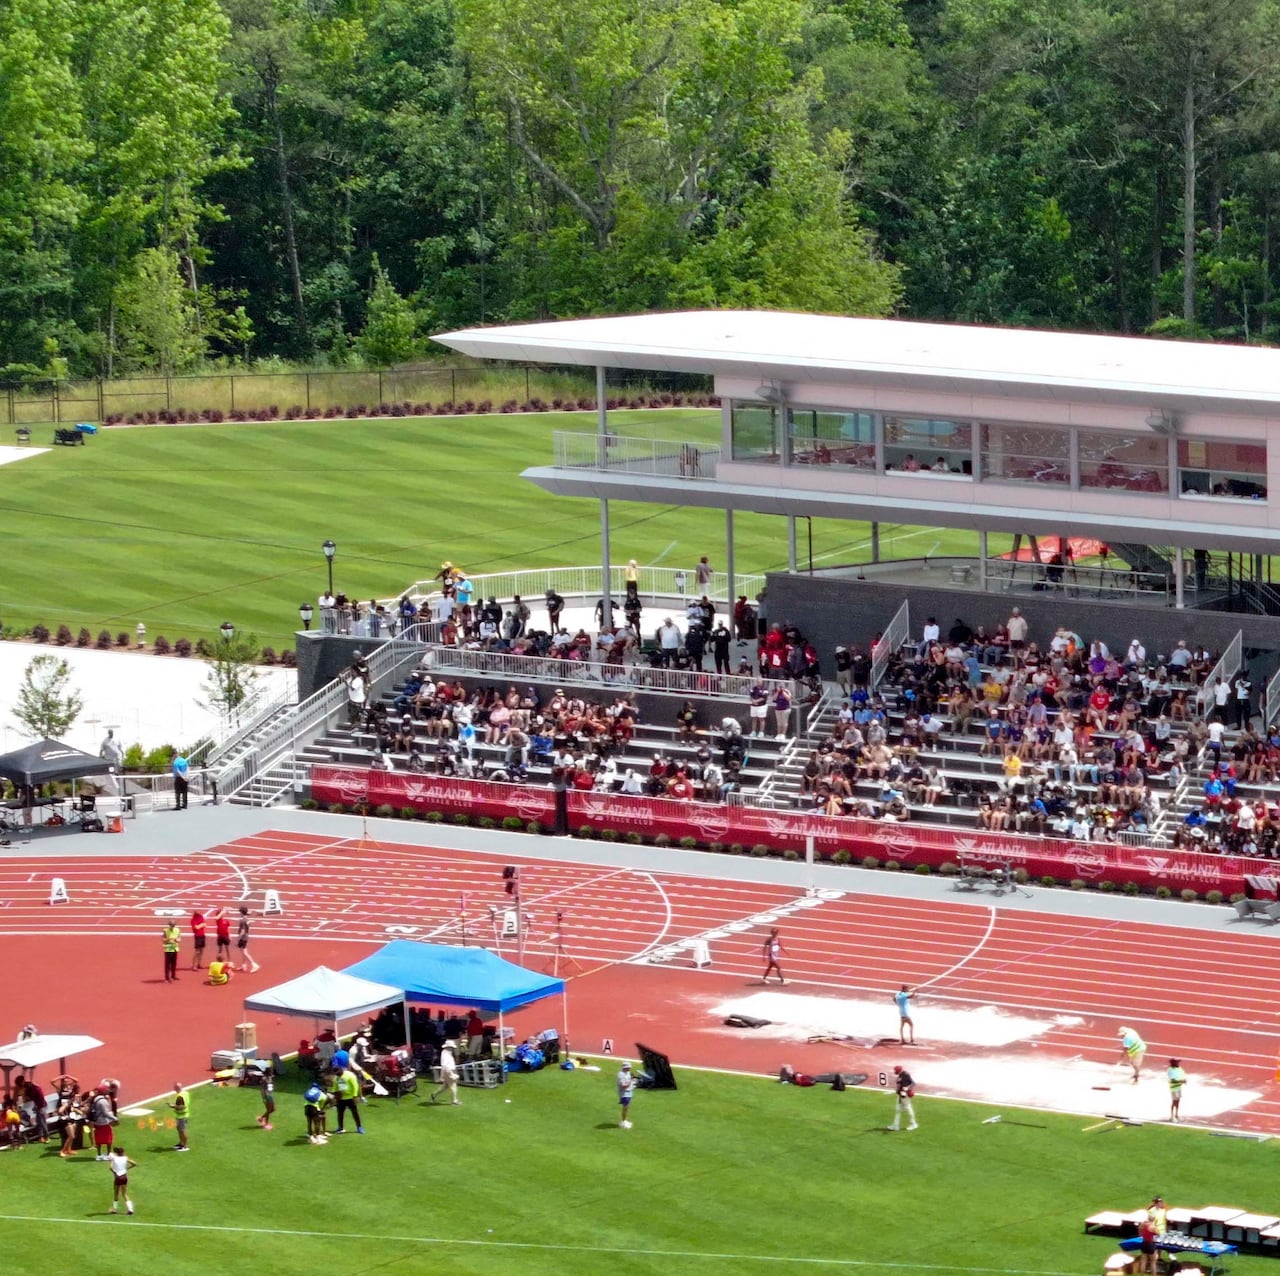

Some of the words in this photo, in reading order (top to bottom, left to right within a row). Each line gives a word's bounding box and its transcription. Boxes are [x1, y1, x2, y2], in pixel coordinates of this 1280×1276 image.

[426, 786, 473, 801] ATLANTA
[606, 804, 654, 820] ATLANTA
[791, 822, 838, 838] ATLANTA
[1170, 861, 1221, 878] ATLANTA
[269, 898, 277, 910] 3
[507, 921, 514, 932] 2
